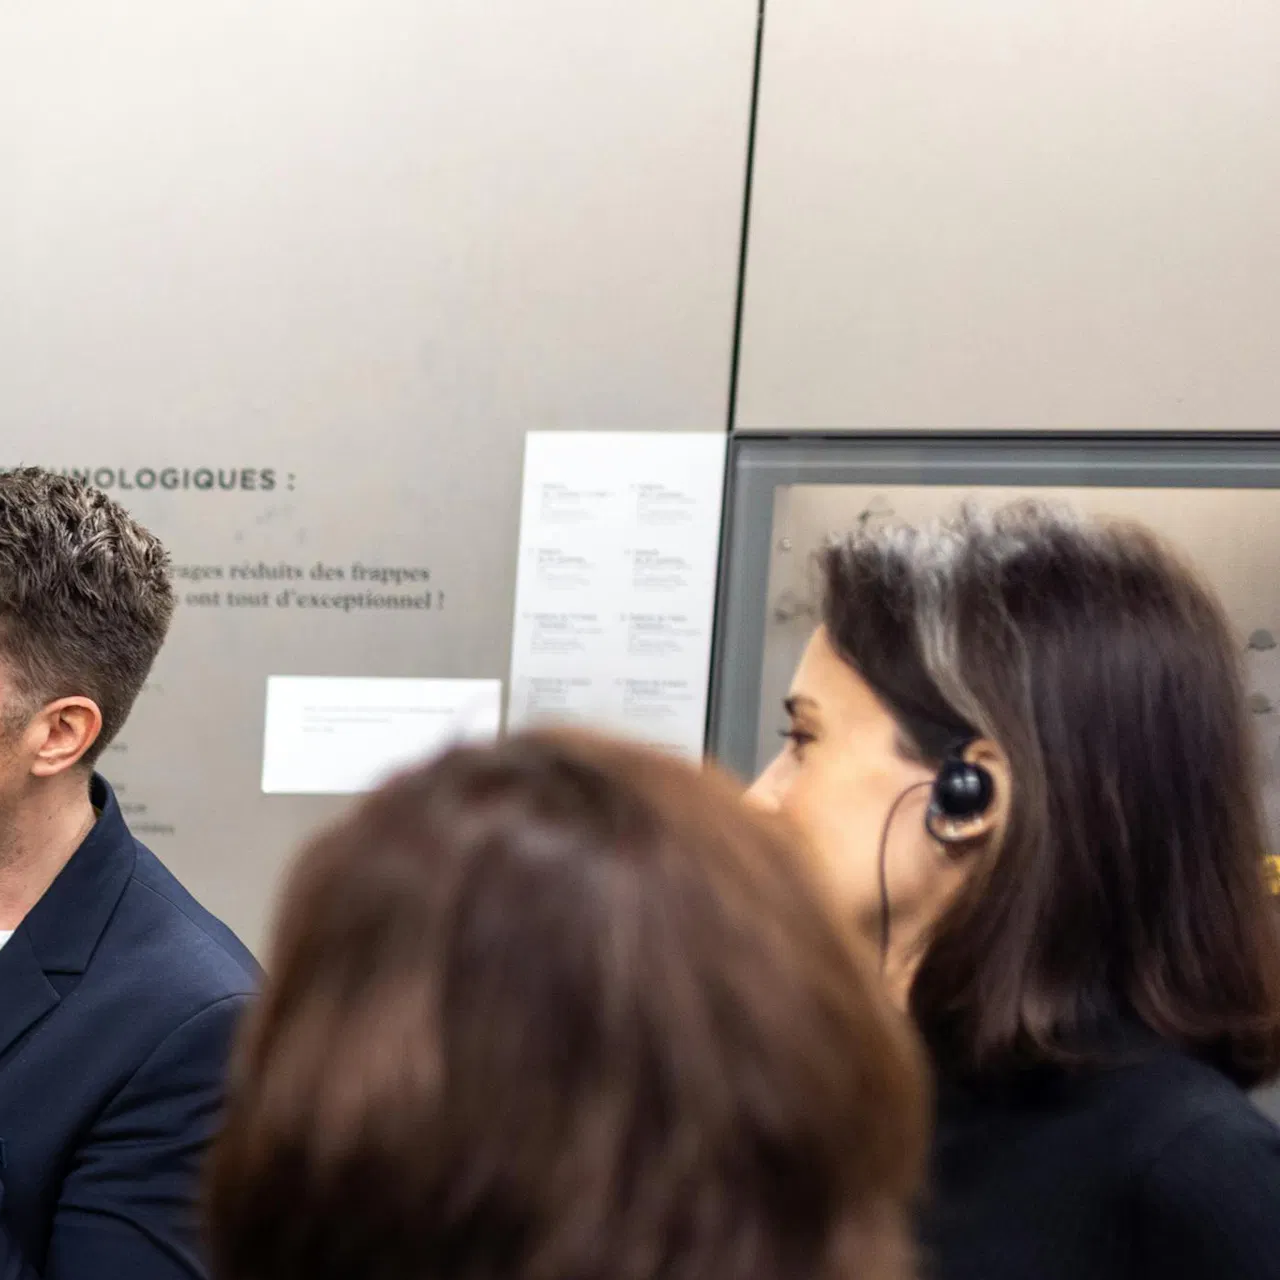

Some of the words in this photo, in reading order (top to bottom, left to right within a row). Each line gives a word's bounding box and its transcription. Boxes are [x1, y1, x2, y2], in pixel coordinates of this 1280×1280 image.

[310, 561, 345, 581] des
[351, 561, 431, 585] frappes
[227, 590, 269, 608] tout
